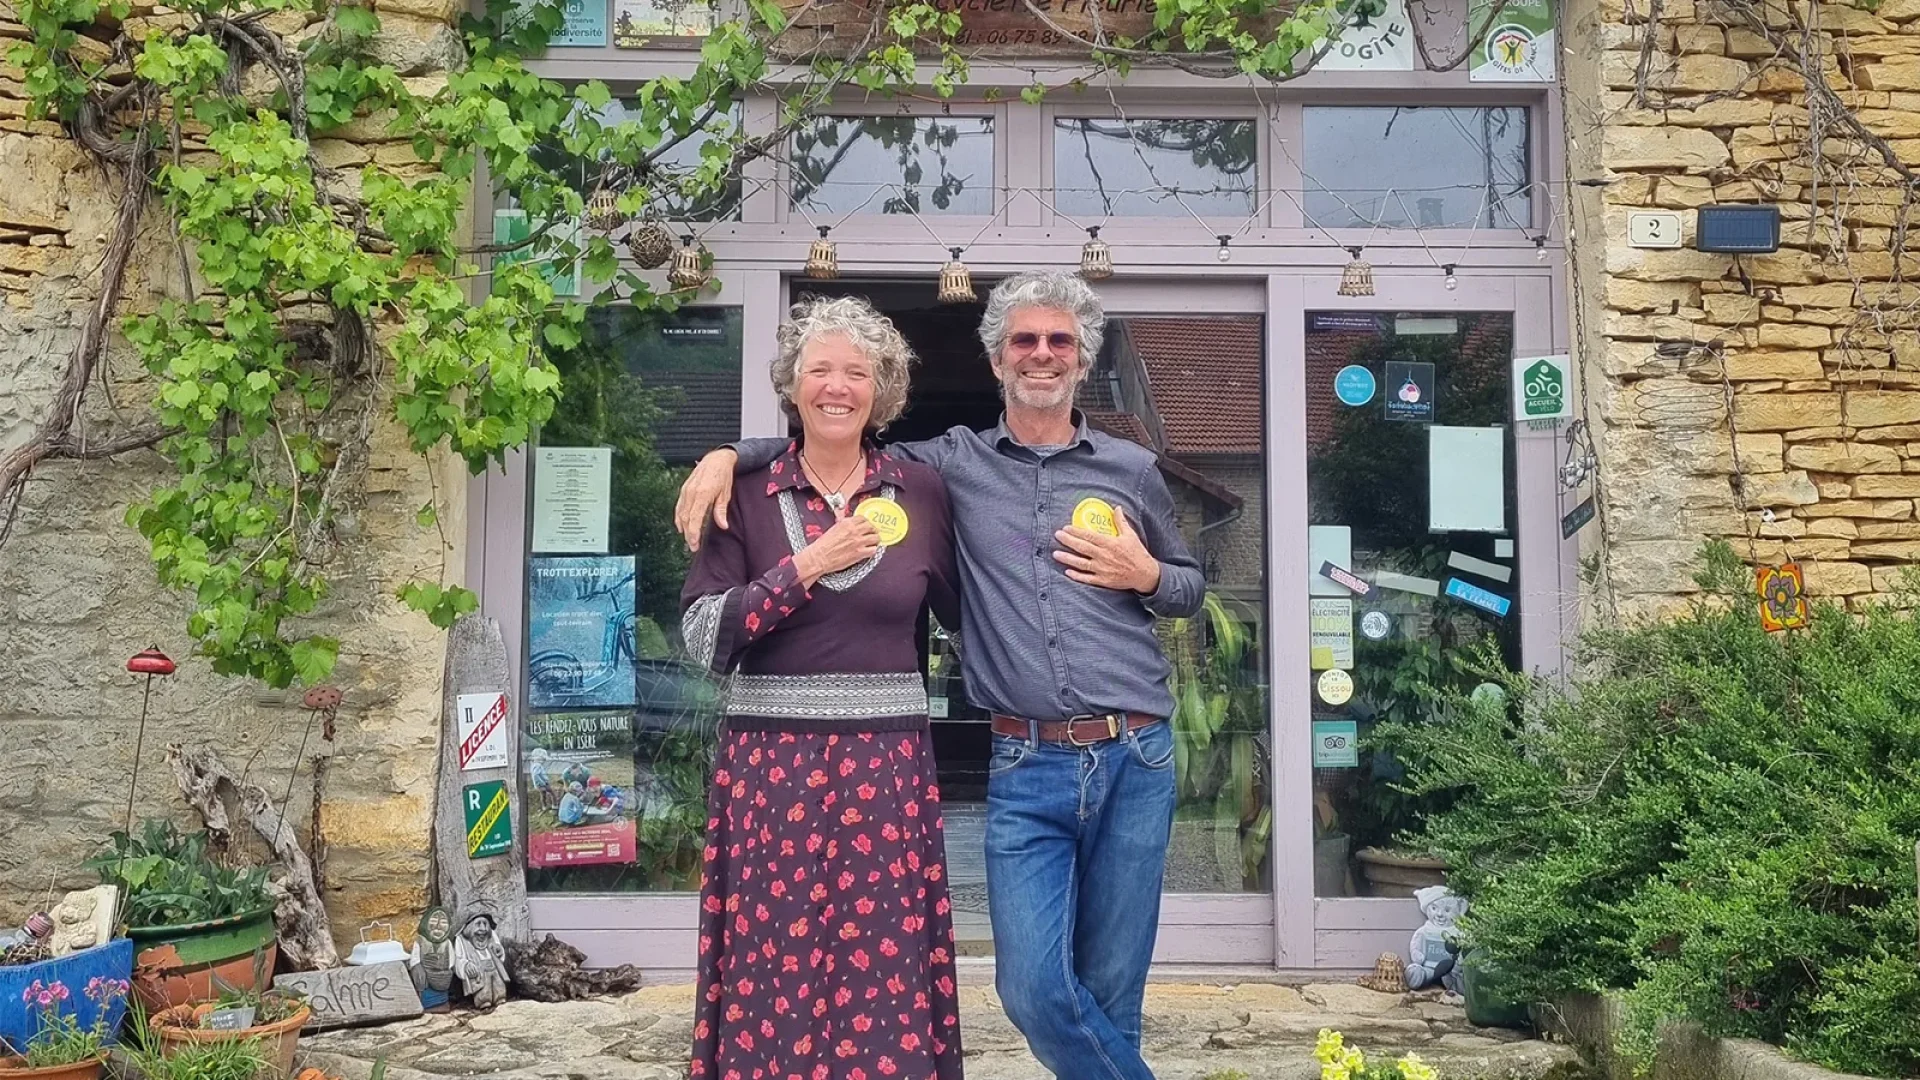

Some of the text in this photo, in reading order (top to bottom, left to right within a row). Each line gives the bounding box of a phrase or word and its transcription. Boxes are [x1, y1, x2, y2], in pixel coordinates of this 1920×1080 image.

[987, 30, 1008, 44] 06
[1014, 29, 1037, 44] 75
[1648, 218, 1661, 239] 2
[1528, 399, 1557, 408] ACCUEIL
[872, 511, 898, 527] 2024
[1090, 512, 1112, 527] 2024
[1312, 616, 1351, 631] 100%
[461, 699, 504, 764] LICENCE
[529, 715, 629, 735] LES RENDEZ-VOUS NATURE
[563, 732, 597, 750] EN ISÈRE
[468, 789, 481, 811] R
